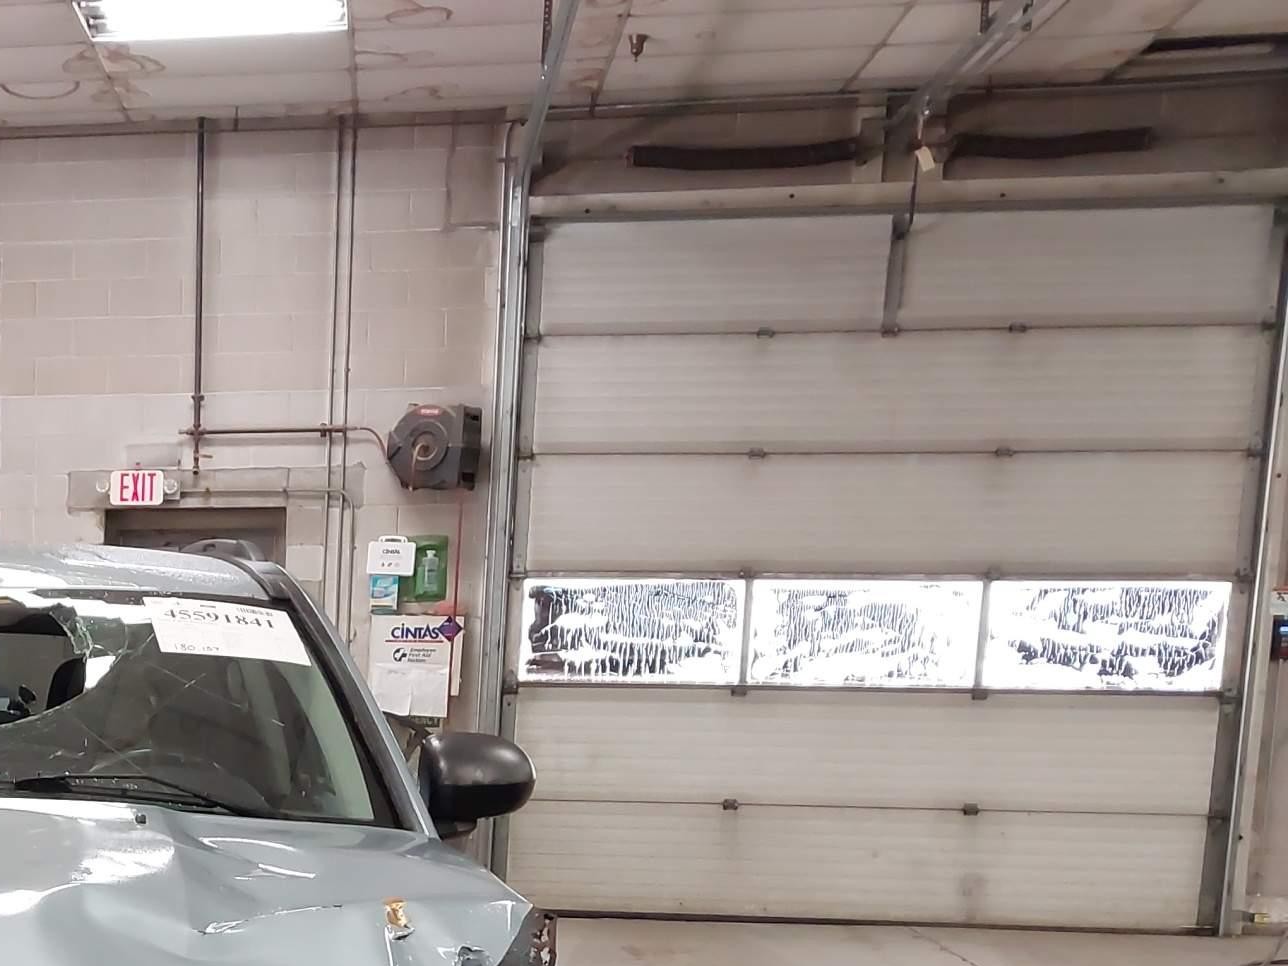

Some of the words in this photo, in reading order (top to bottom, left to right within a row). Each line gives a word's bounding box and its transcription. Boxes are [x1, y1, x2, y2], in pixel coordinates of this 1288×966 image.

[120, 472, 157, 502] EXIT
[164, 609, 275, 629] 45591841
[391, 622, 440, 640] CINTAS
